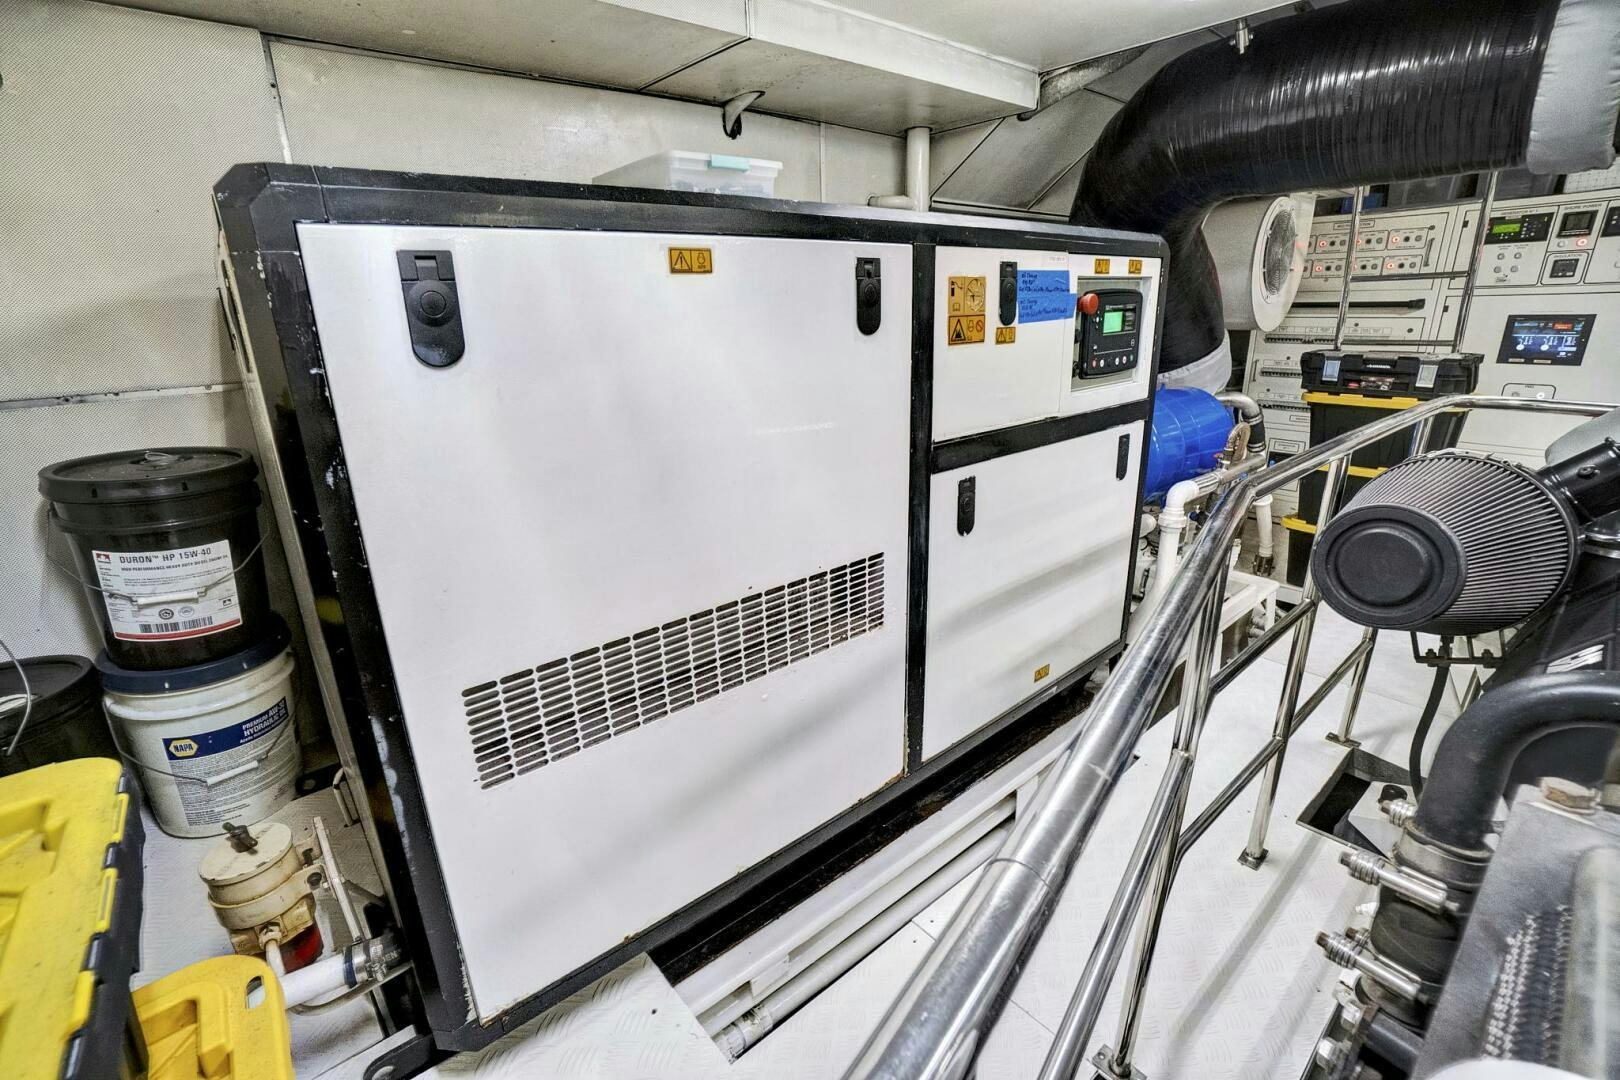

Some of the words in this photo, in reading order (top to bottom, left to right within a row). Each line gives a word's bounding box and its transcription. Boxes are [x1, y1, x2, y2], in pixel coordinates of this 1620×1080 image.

[162, 553, 175, 562] HP
[179, 547, 212, 560] 15W-40
[242, 714, 268, 731] PREMIUM
[243, 713, 279, 737] HYDRAULIC
[173, 742, 194, 753] NAPA
